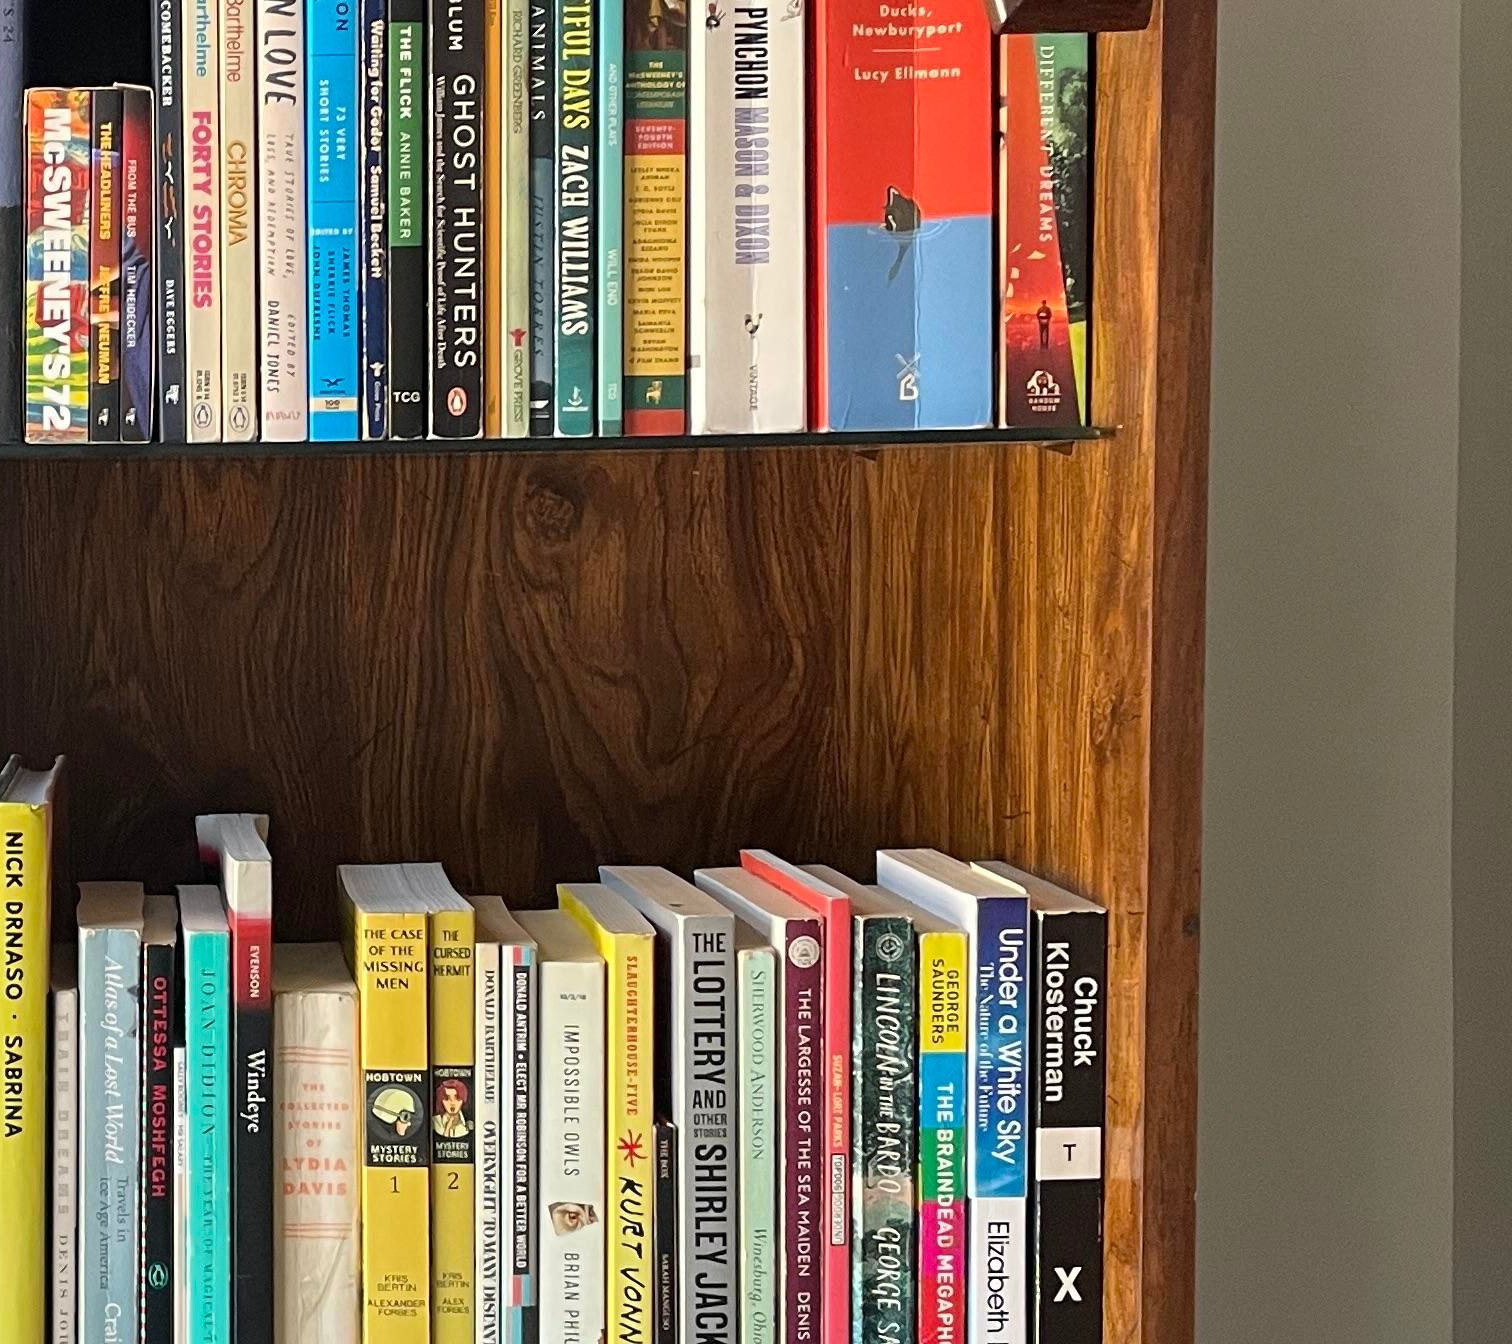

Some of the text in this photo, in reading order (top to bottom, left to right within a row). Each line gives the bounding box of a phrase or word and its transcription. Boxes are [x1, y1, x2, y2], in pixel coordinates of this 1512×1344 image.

[263, 30, 298, 107] LOVE
[398, 25, 412, 120] THE FLICK
[852, 23, 964, 39] Newburyport
[853, 67, 962, 81] Lucy Ellmann
[562, 67, 590, 130] DAYS
[191, 110, 214, 309] FORTY STORIES
[399, 131, 412, 239] ANNIE BAKER
[451, 74, 476, 369] GHOST HUNTERS
[560, 144, 590, 336] ZACH WILLIAMS
[3, 831, 25, 1138] NICK DRNASO SABRINA
[691, 960, 726, 1084] LOTTERY
[930, 958, 947, 1045] SAUNDERS
[945, 969, 960, 1033] GEORGE
[1044, 941, 1070, 1102] Klosterman
[1071, 976, 1098, 1066] Chuck
[243, 1049, 266, 1134] Windeye
[991, 928, 1023, 1164] Under a White Sky
[563, 1024, 582, 1177] IMPOSSIBLE OWLS
[937, 1083, 954, 1123] THE
[693, 1143, 729, 1266] SHIRLEY
[936, 1128, 955, 1248] BRAINDEAD
[563, 1252, 581, 1301] BRIAN
[985, 1221, 1012, 1334] Elizabeth
